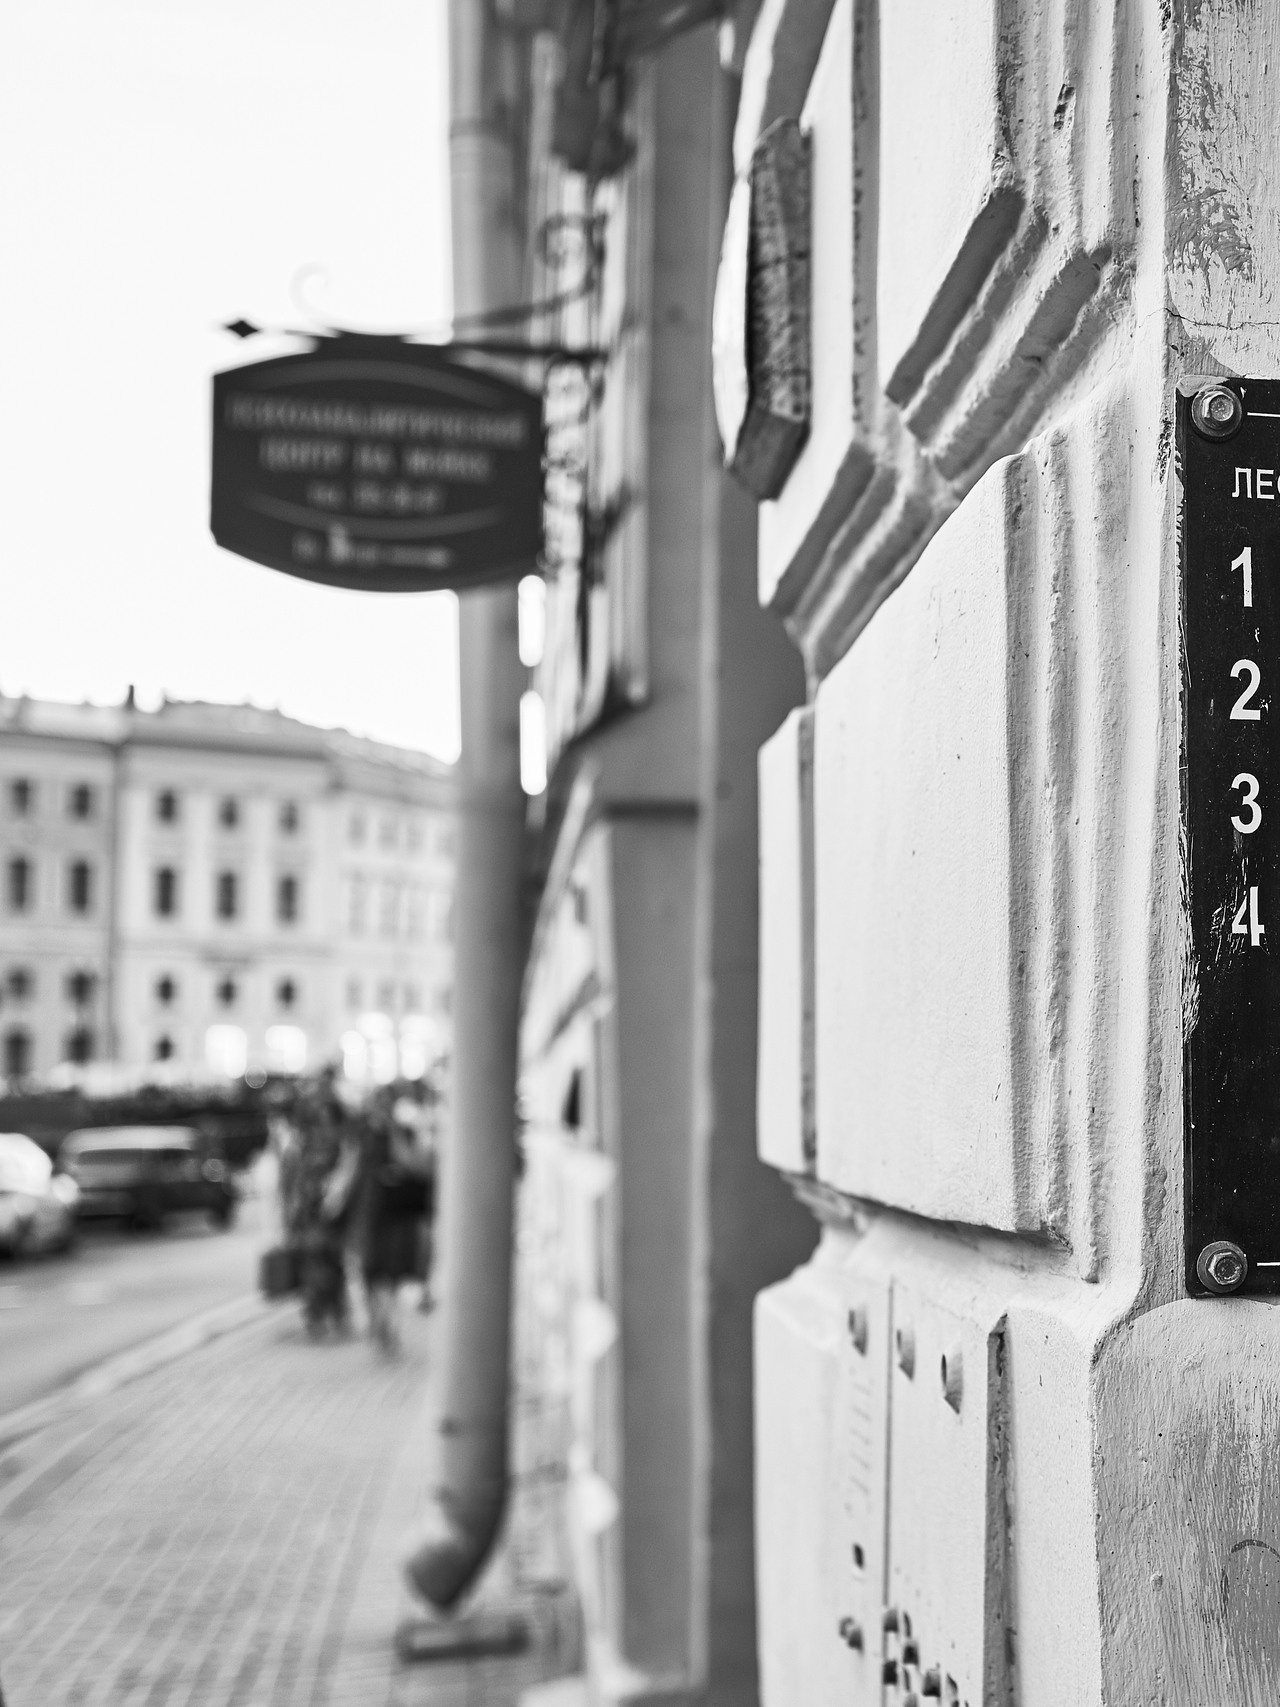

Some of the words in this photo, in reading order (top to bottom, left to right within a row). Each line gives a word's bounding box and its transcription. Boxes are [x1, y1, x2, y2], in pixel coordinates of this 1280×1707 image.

[1230, 546, 1253, 608] 1
[1229, 658, 1261, 721] 2
[1230, 772, 1263, 835] 3
[1230, 885, 1266, 947] 4
